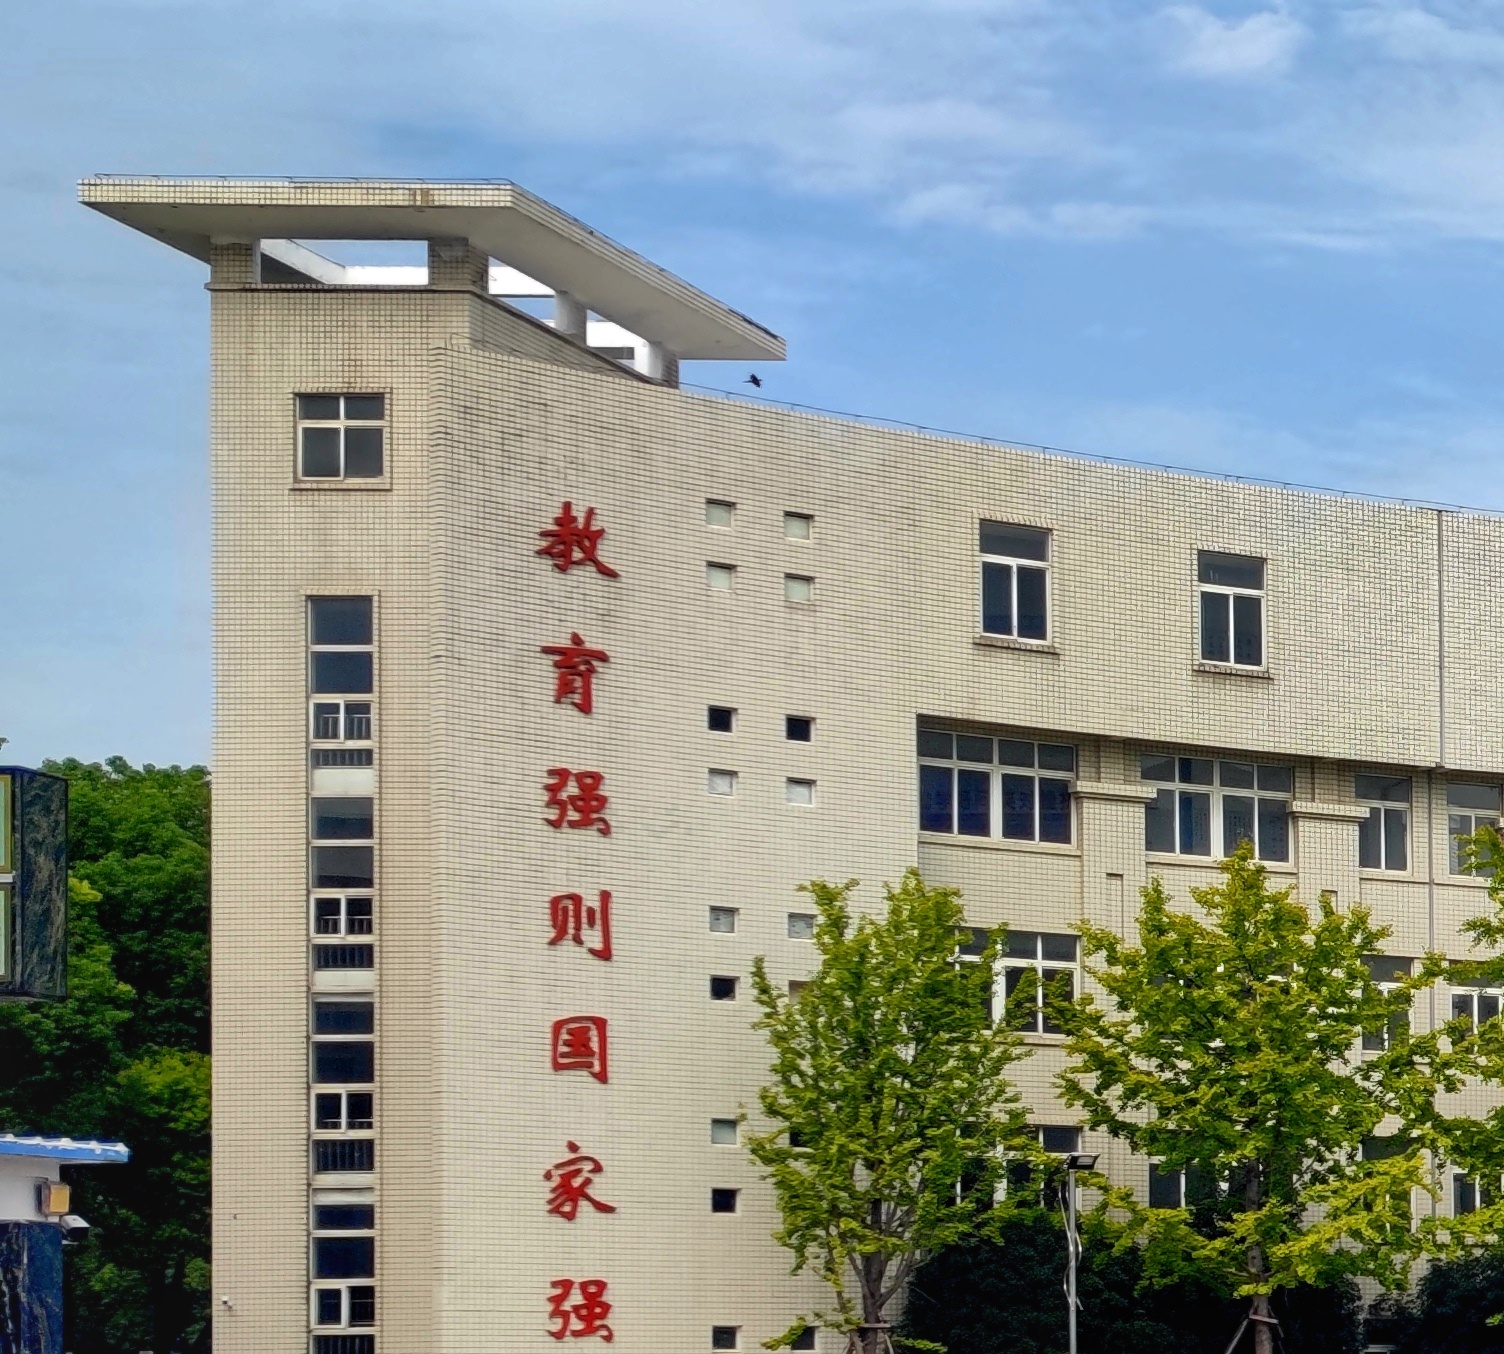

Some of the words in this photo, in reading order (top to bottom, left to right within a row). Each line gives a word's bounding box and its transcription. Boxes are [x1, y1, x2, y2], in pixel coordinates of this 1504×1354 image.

[536, 502, 620, 1343] 教育强则国家强
